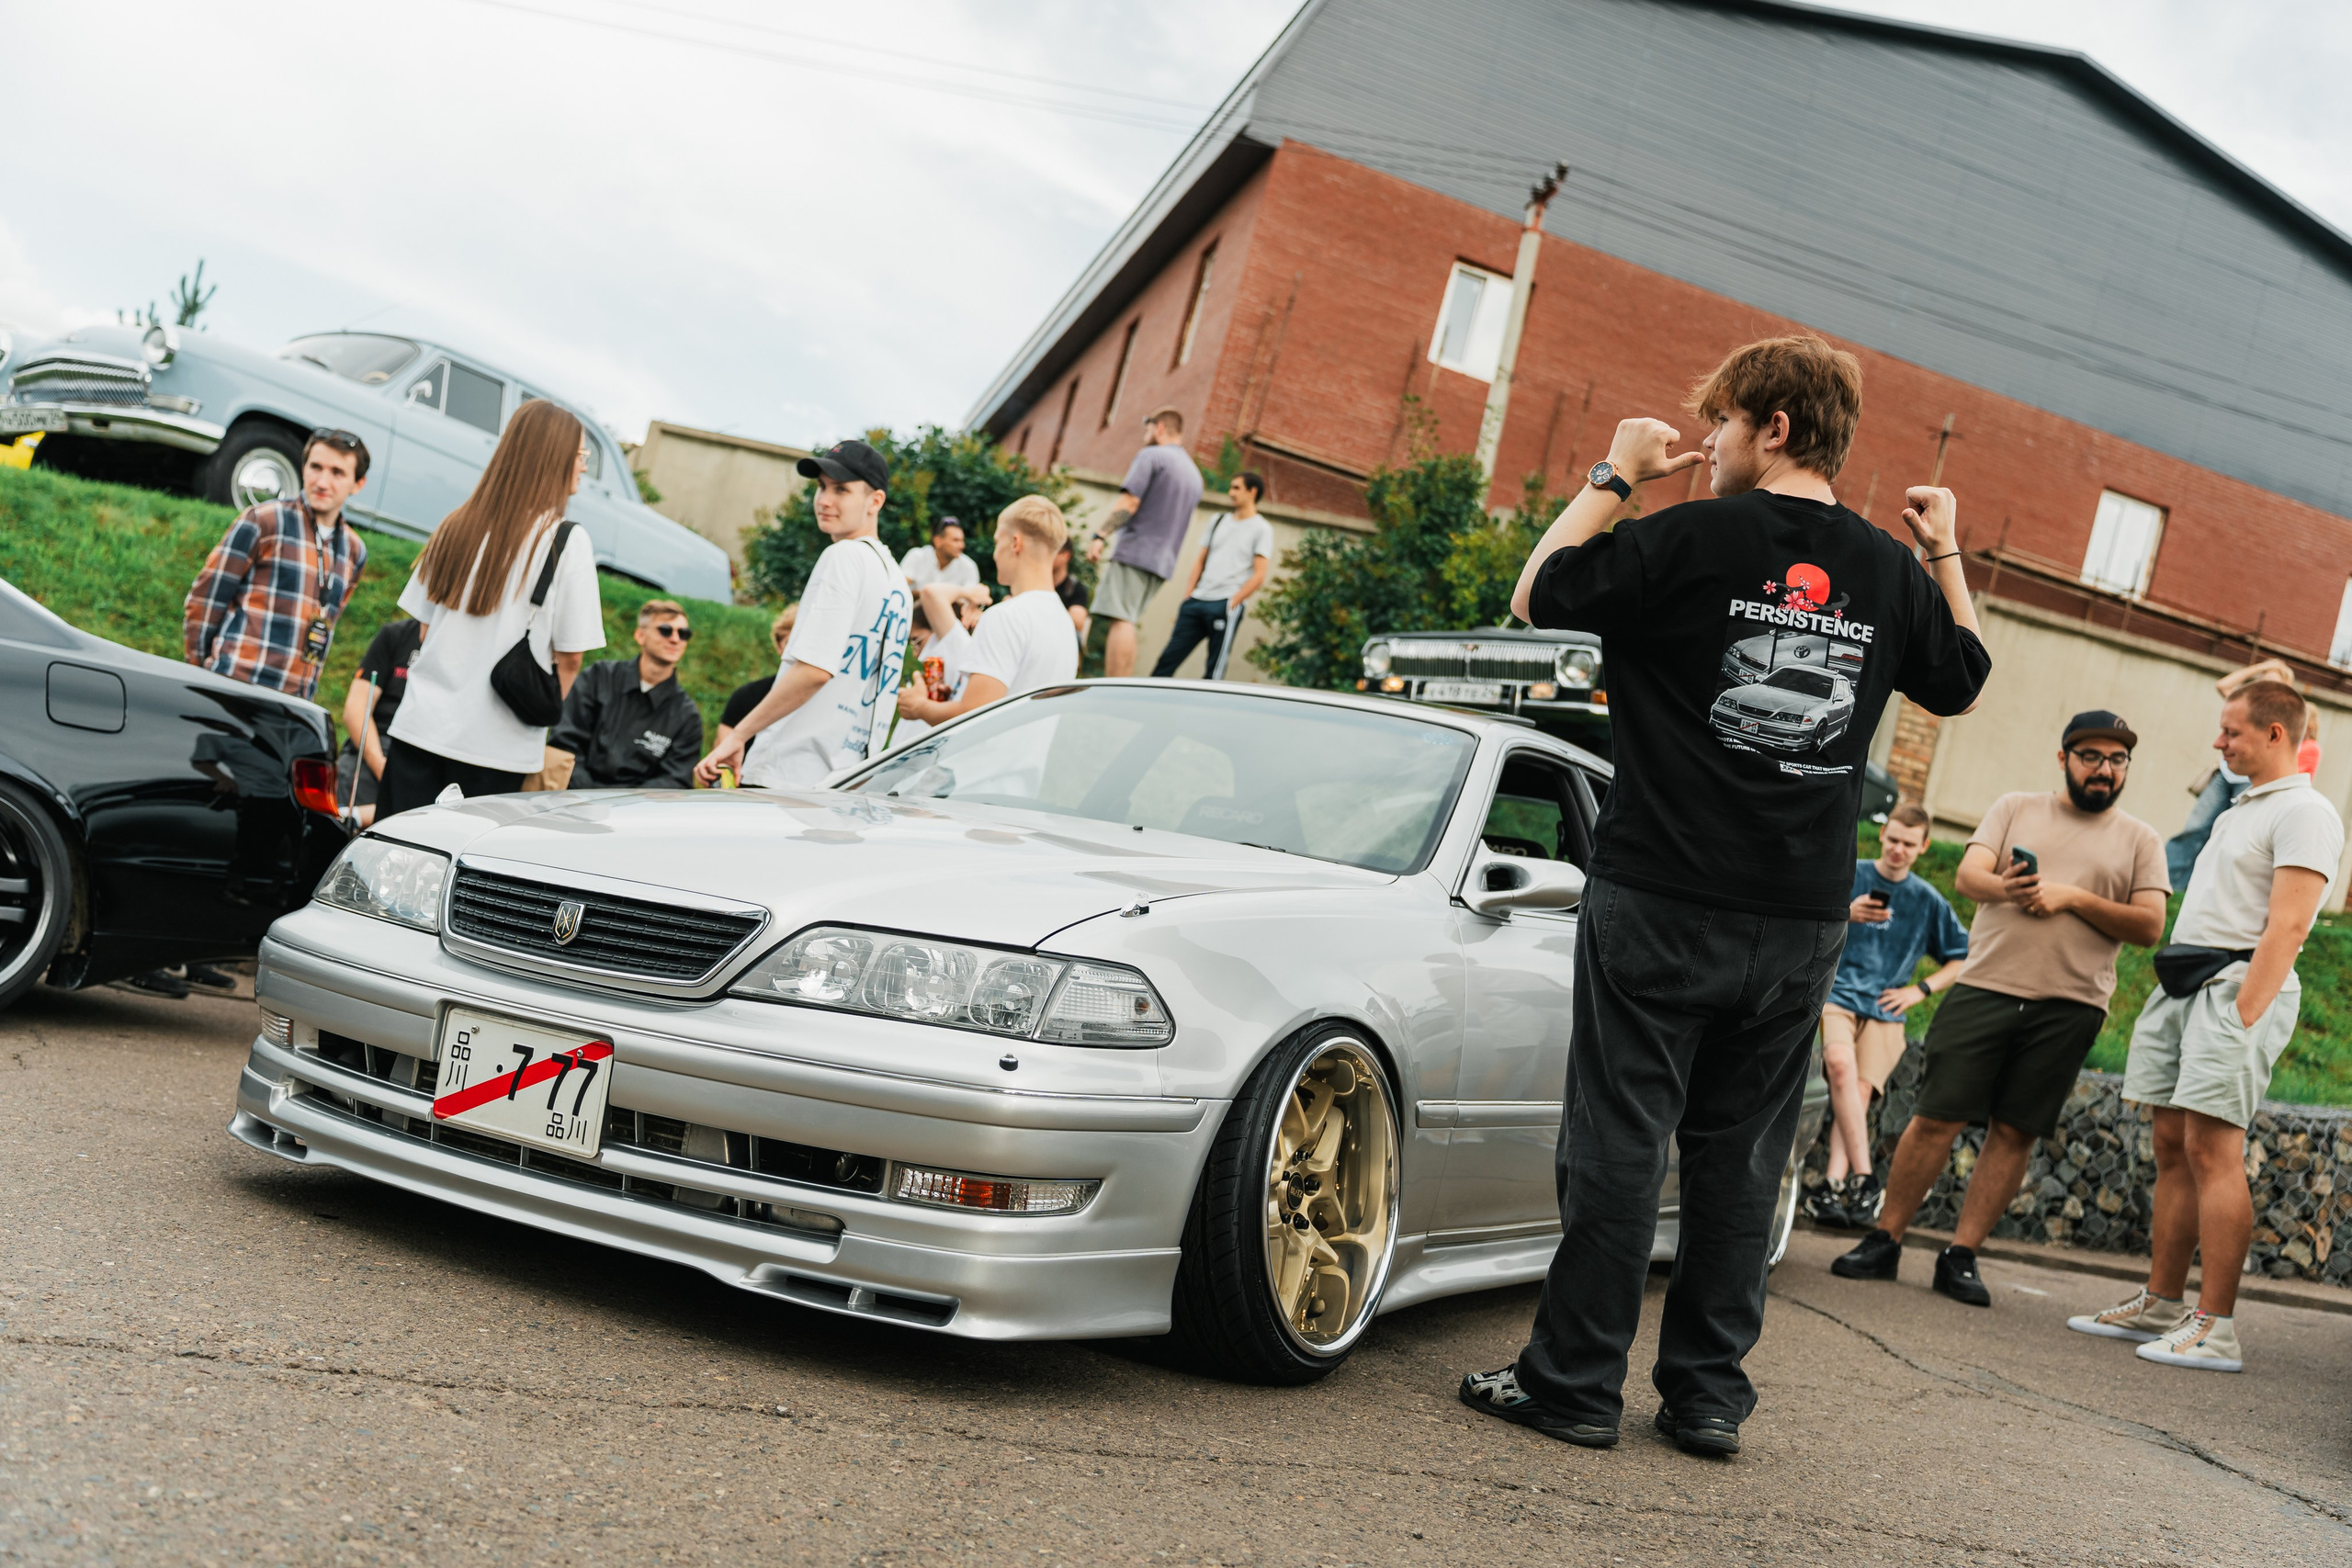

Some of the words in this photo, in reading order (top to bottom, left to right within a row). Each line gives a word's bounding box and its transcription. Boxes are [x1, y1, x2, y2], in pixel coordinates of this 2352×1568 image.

[1728, 599, 1874, 643] PERSISTENCE
[1198, 806, 1264, 825] RECARO
[546, 1111, 588, 1145] 品川
